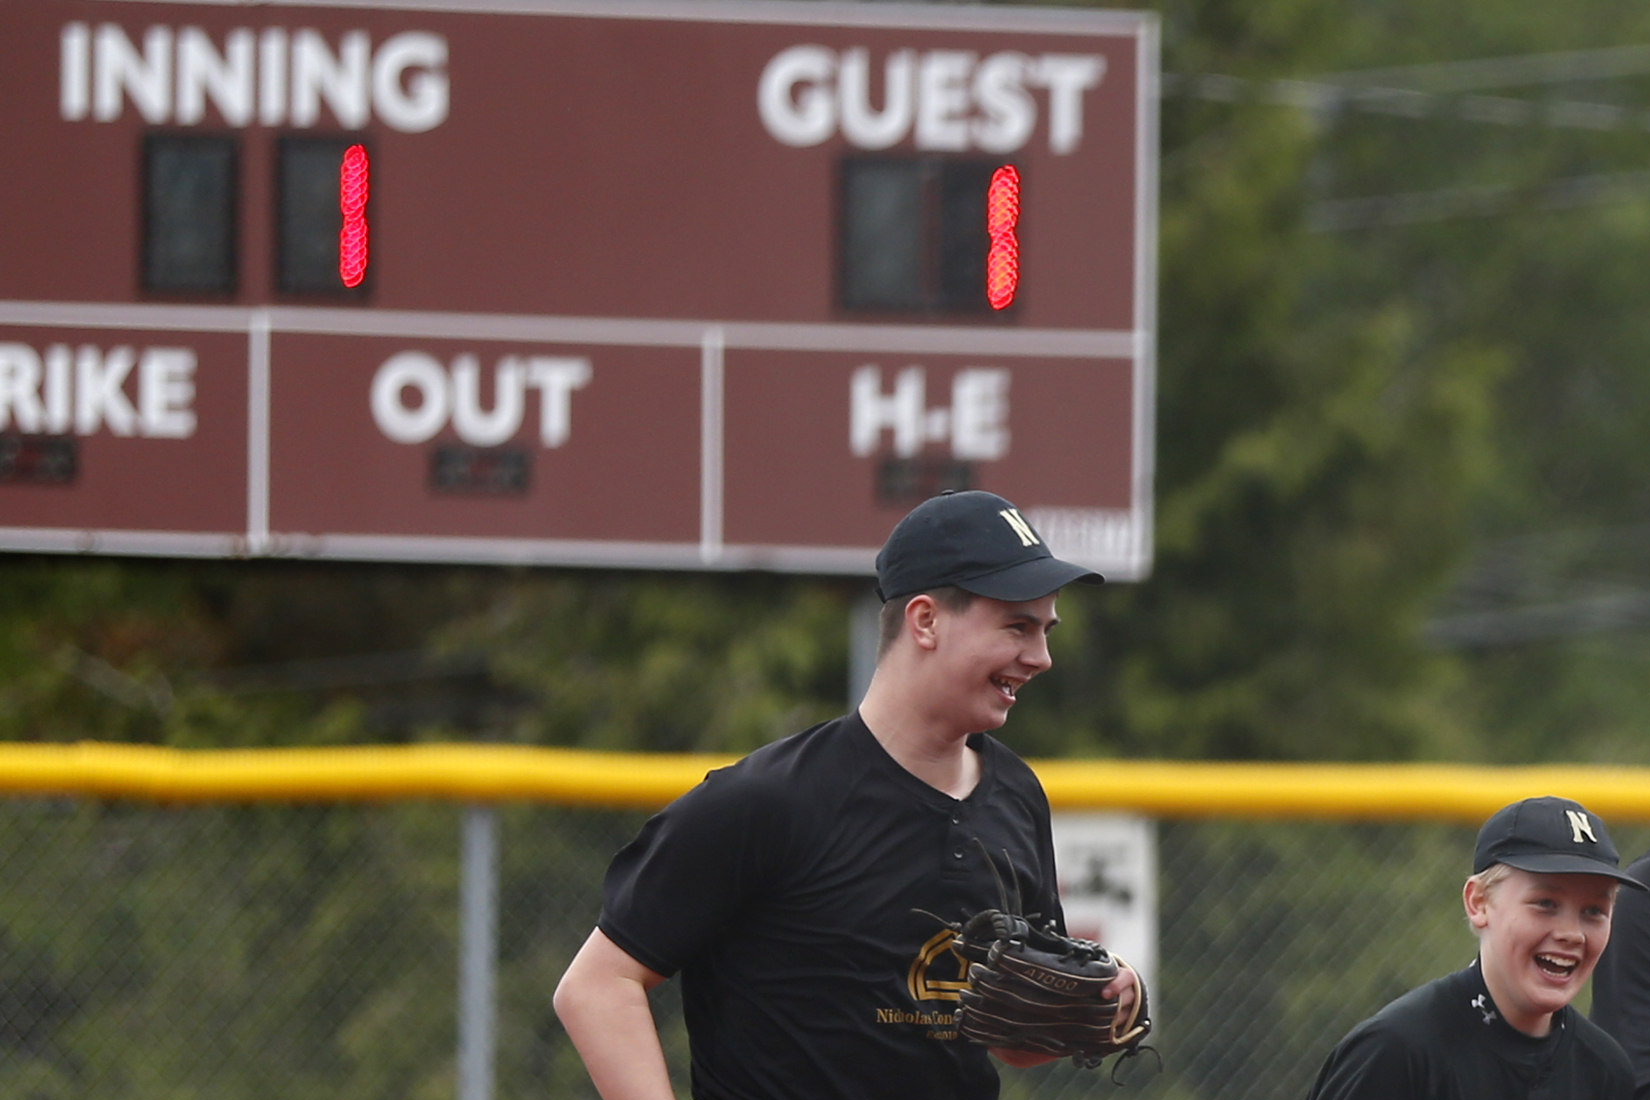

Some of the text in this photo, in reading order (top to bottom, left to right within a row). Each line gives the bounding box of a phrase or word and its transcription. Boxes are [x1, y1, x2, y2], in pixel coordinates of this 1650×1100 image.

[60, 21, 450, 133] INNING
[757, 44, 1106, 154] GUEST
[340, 144, 368, 287] 1
[988, 164, 1018, 310] 1
[369, 349, 592, 447] OUT
[848, 362, 1013, 461] H-E
[999, 508, 1040, 547] N
[1565, 809, 1598, 843] N
